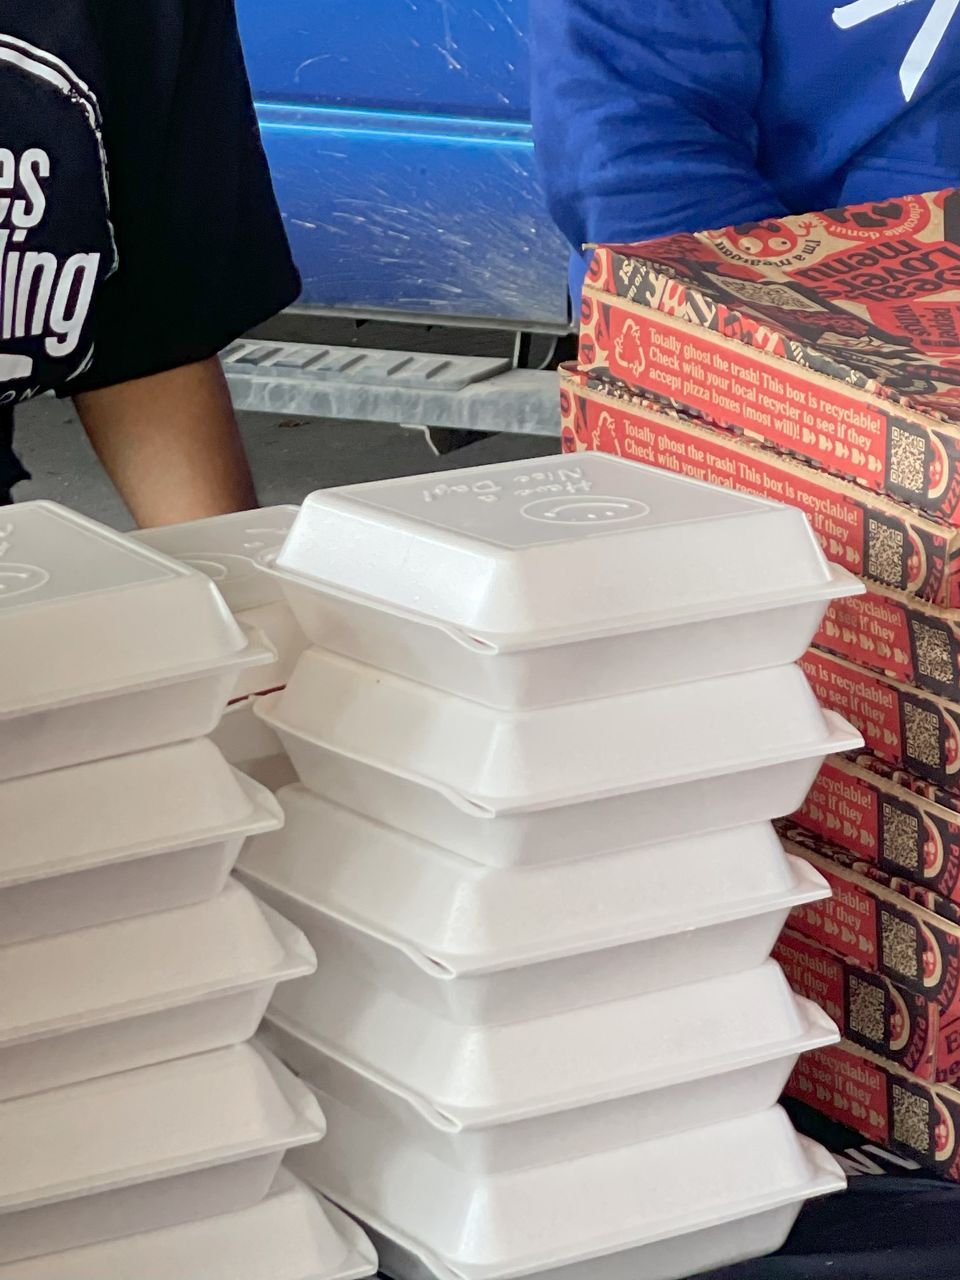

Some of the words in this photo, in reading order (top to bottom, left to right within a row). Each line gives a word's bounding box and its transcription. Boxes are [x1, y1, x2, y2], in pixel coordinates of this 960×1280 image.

[649, 328, 682, 355] Totally
[684, 342, 711, 365] ghost
[713, 353, 729, 372] the
[731, 361, 760, 383] trash!
[762, 373, 784, 394] This
[786, 384, 805, 404] box
[808, 393, 818, 409] is
[820, 399, 881, 434] recyclable!
[649, 347, 680, 370] Check
[683, 360, 705, 381] with
[706, 371, 730, 391] your
[732, 379, 756, 401] local
[758, 392, 800, 421] recycler
[803, 409, 814, 426] to
[816, 418, 835, 435] see
[837, 423, 847, 440] if
[848, 428, 872, 451] they
[649, 367, 682, 391] accept
[683, 381, 710, 401] pizza
[712, 391, 740, 413] boxes
[743, 403, 771, 427] (most
[774, 417, 800, 440] will)!
[623, 419, 655, 446] Totally
[658, 434, 685, 456] ghost
[688, 445, 704, 462] the
[707, 452, 736, 474] trash!
[739, 462, 761, 485] This
[764, 473, 784, 494] box
[786, 481, 795, 498] is
[797, 489, 857, 525] recyclable!
